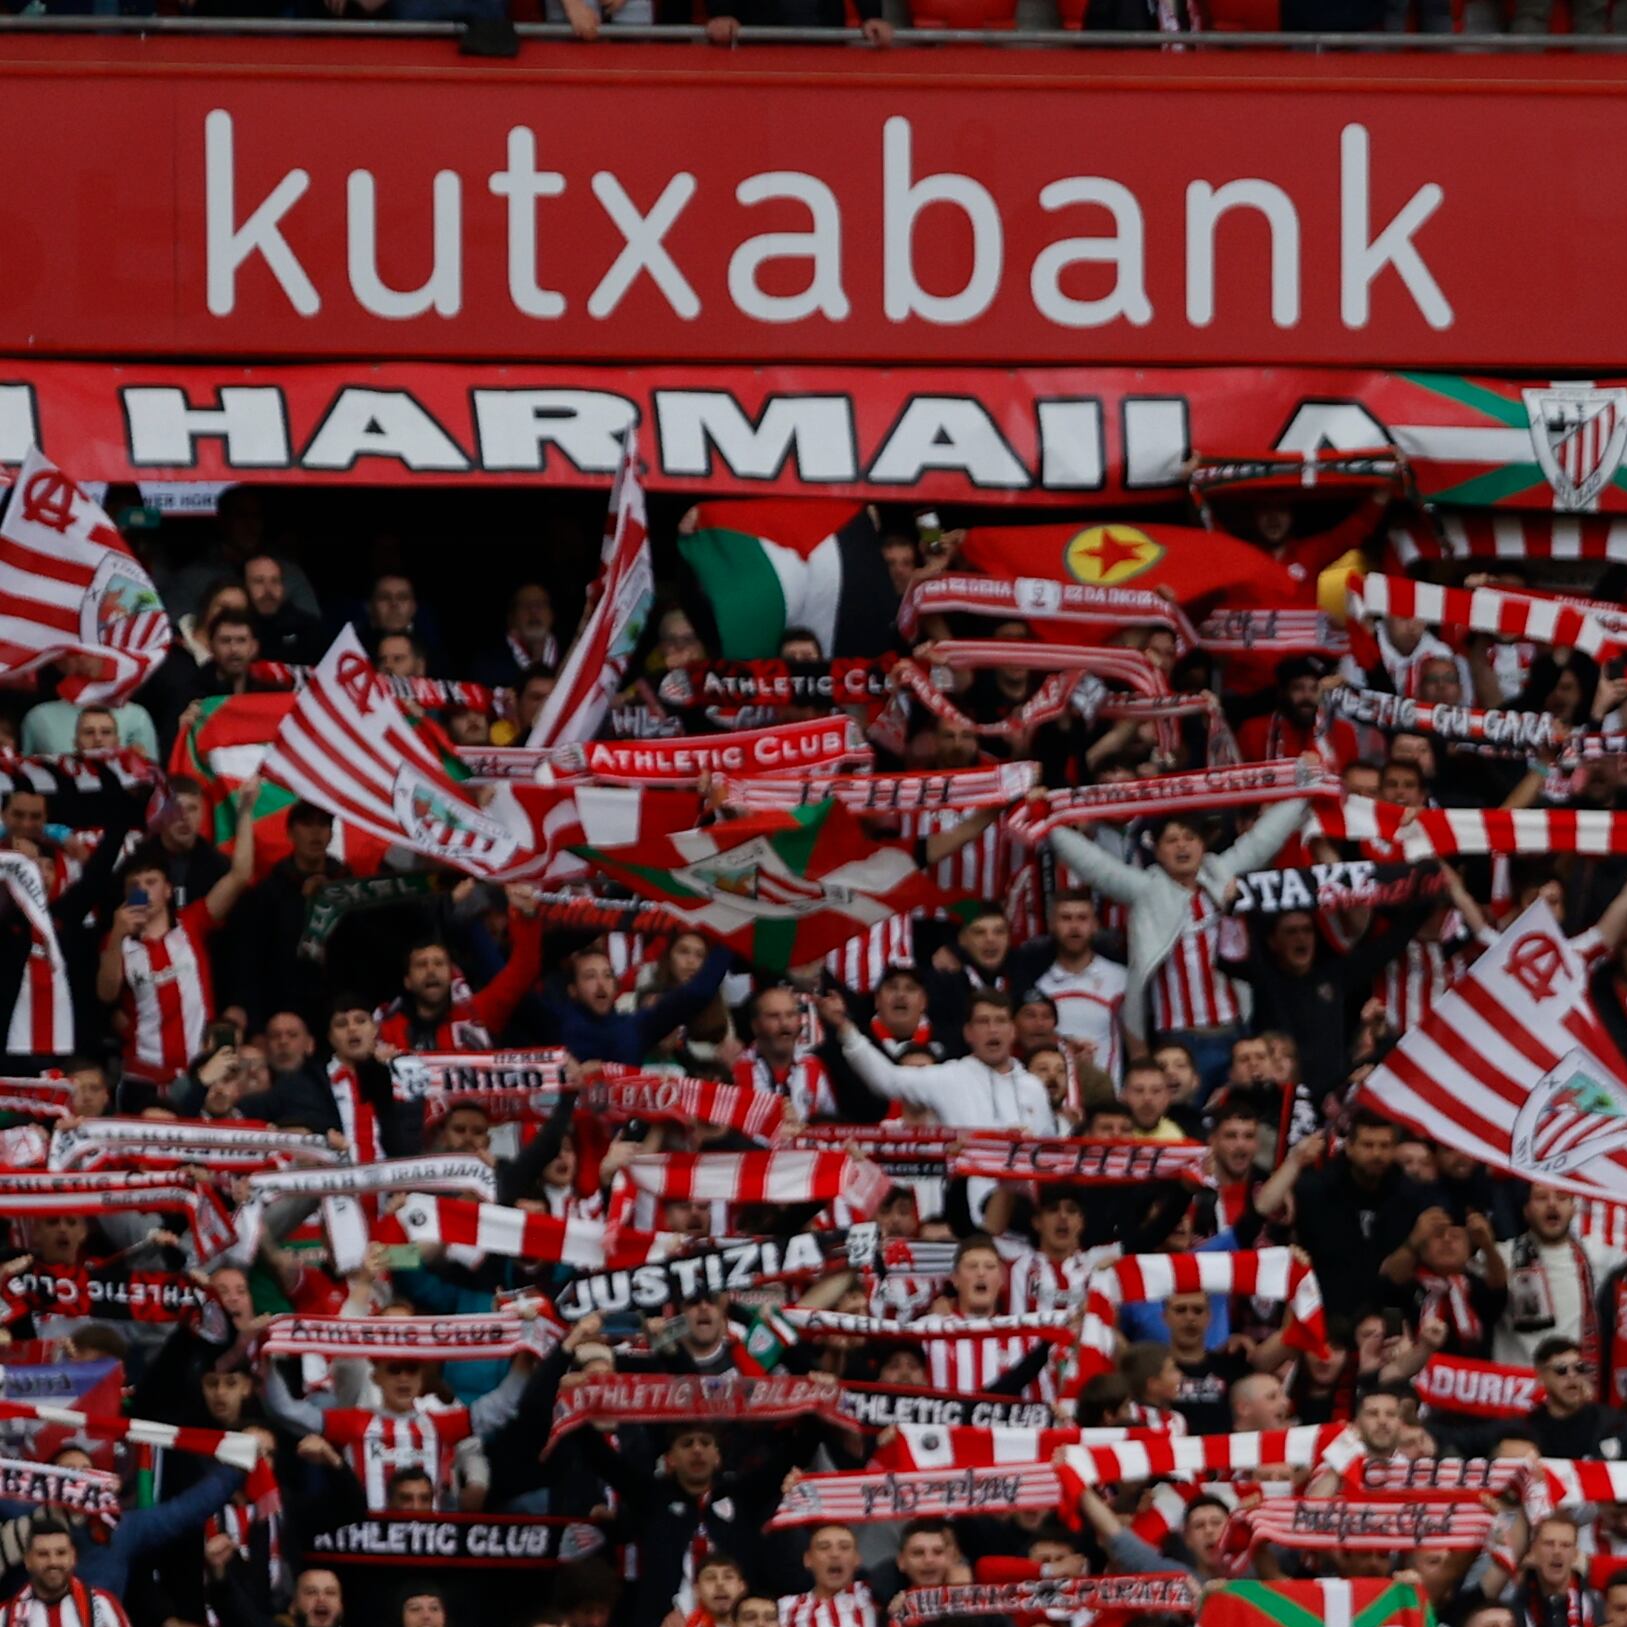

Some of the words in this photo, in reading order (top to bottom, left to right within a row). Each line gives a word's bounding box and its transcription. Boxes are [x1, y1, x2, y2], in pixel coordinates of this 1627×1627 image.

[204, 108, 1456, 330] kutxabank
[703, 666, 832, 699] ATHLETIC
[592, 736, 740, 773] ATHLETIC
[752, 726, 840, 763] CLUB
[1004, 1143, 1164, 1177] ICHH
[557, 1231, 823, 1321] JUSTIZIA
[290, 1318, 424, 1343] ATHLETIC
[430, 1320, 502, 1342] CLUB
[572, 1383, 692, 1413] ATHLETIC
[972, 1402, 1051, 1429] CLUB
[313, 1521, 458, 1552] ATHLETIC
[465, 1523, 549, 1556] CLUB
